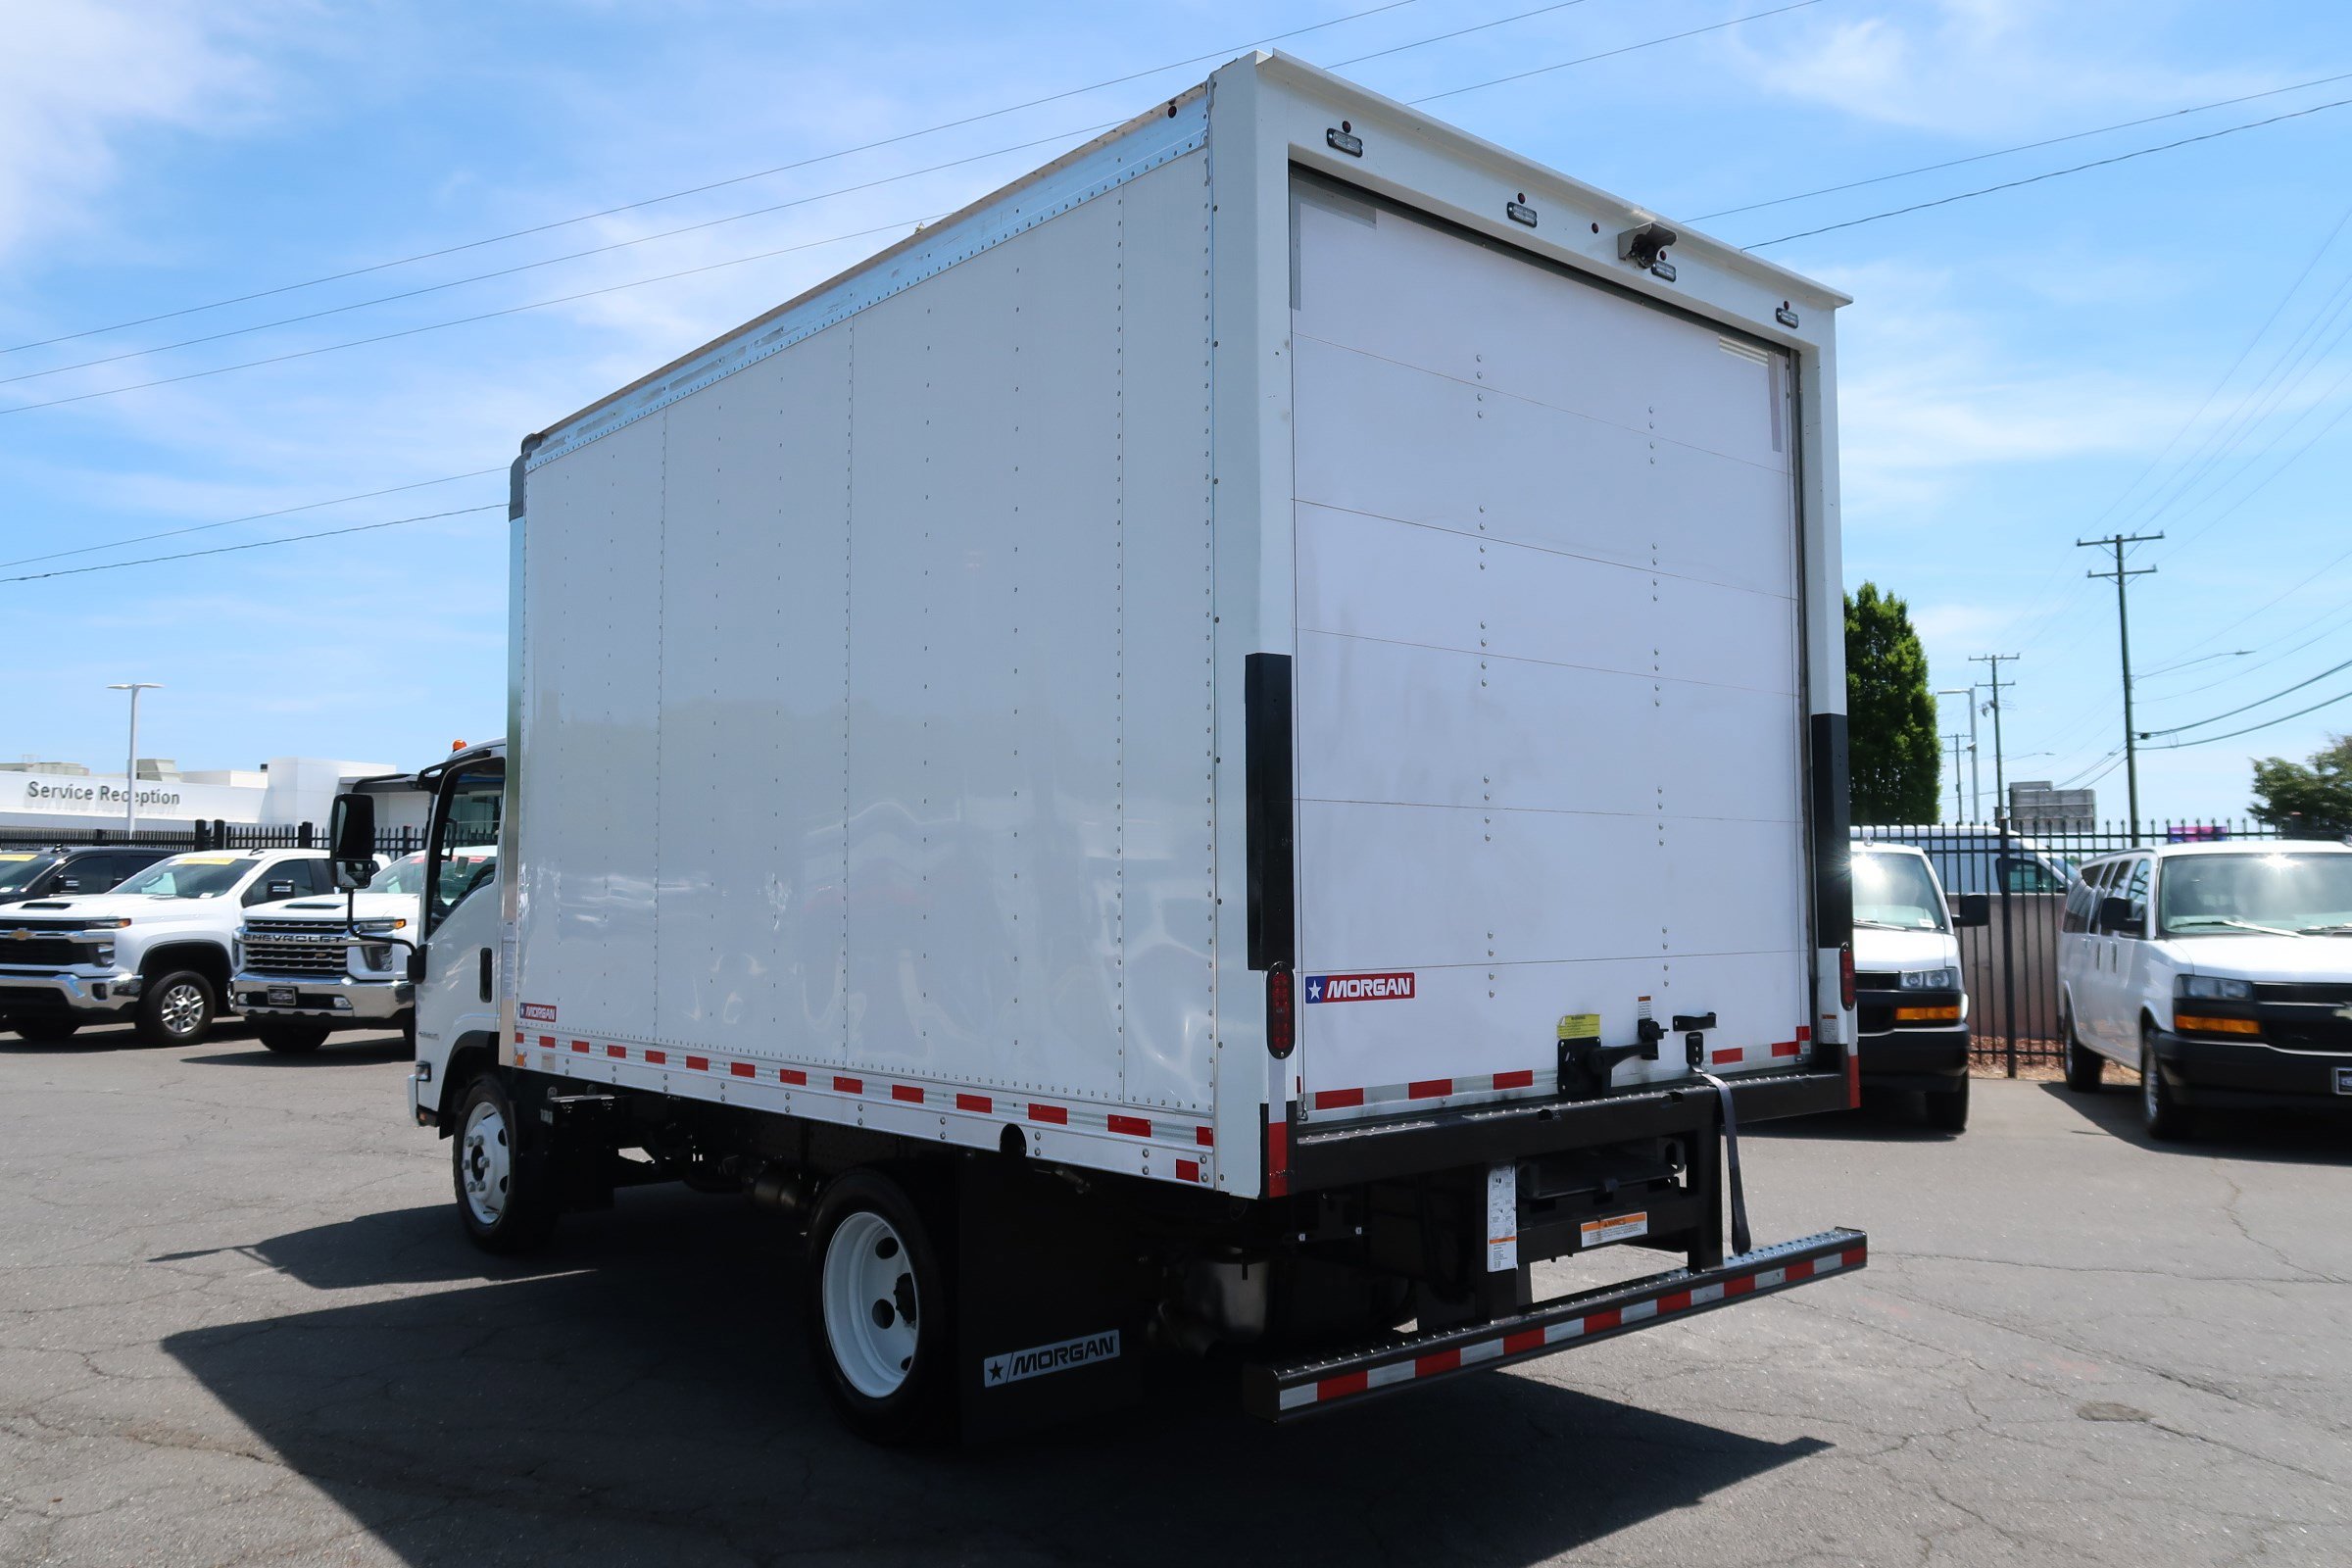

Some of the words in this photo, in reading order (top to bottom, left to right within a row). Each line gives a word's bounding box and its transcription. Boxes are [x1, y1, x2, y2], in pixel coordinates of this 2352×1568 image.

[27, 781, 94, 801] Service
[243, 934, 344, 943] CHEVROLET
[1326, 977, 1410, 999] MORGAN
[525, 1005, 556, 1019] MORGAN
[1012, 1336, 1115, 1376] MORGAN
